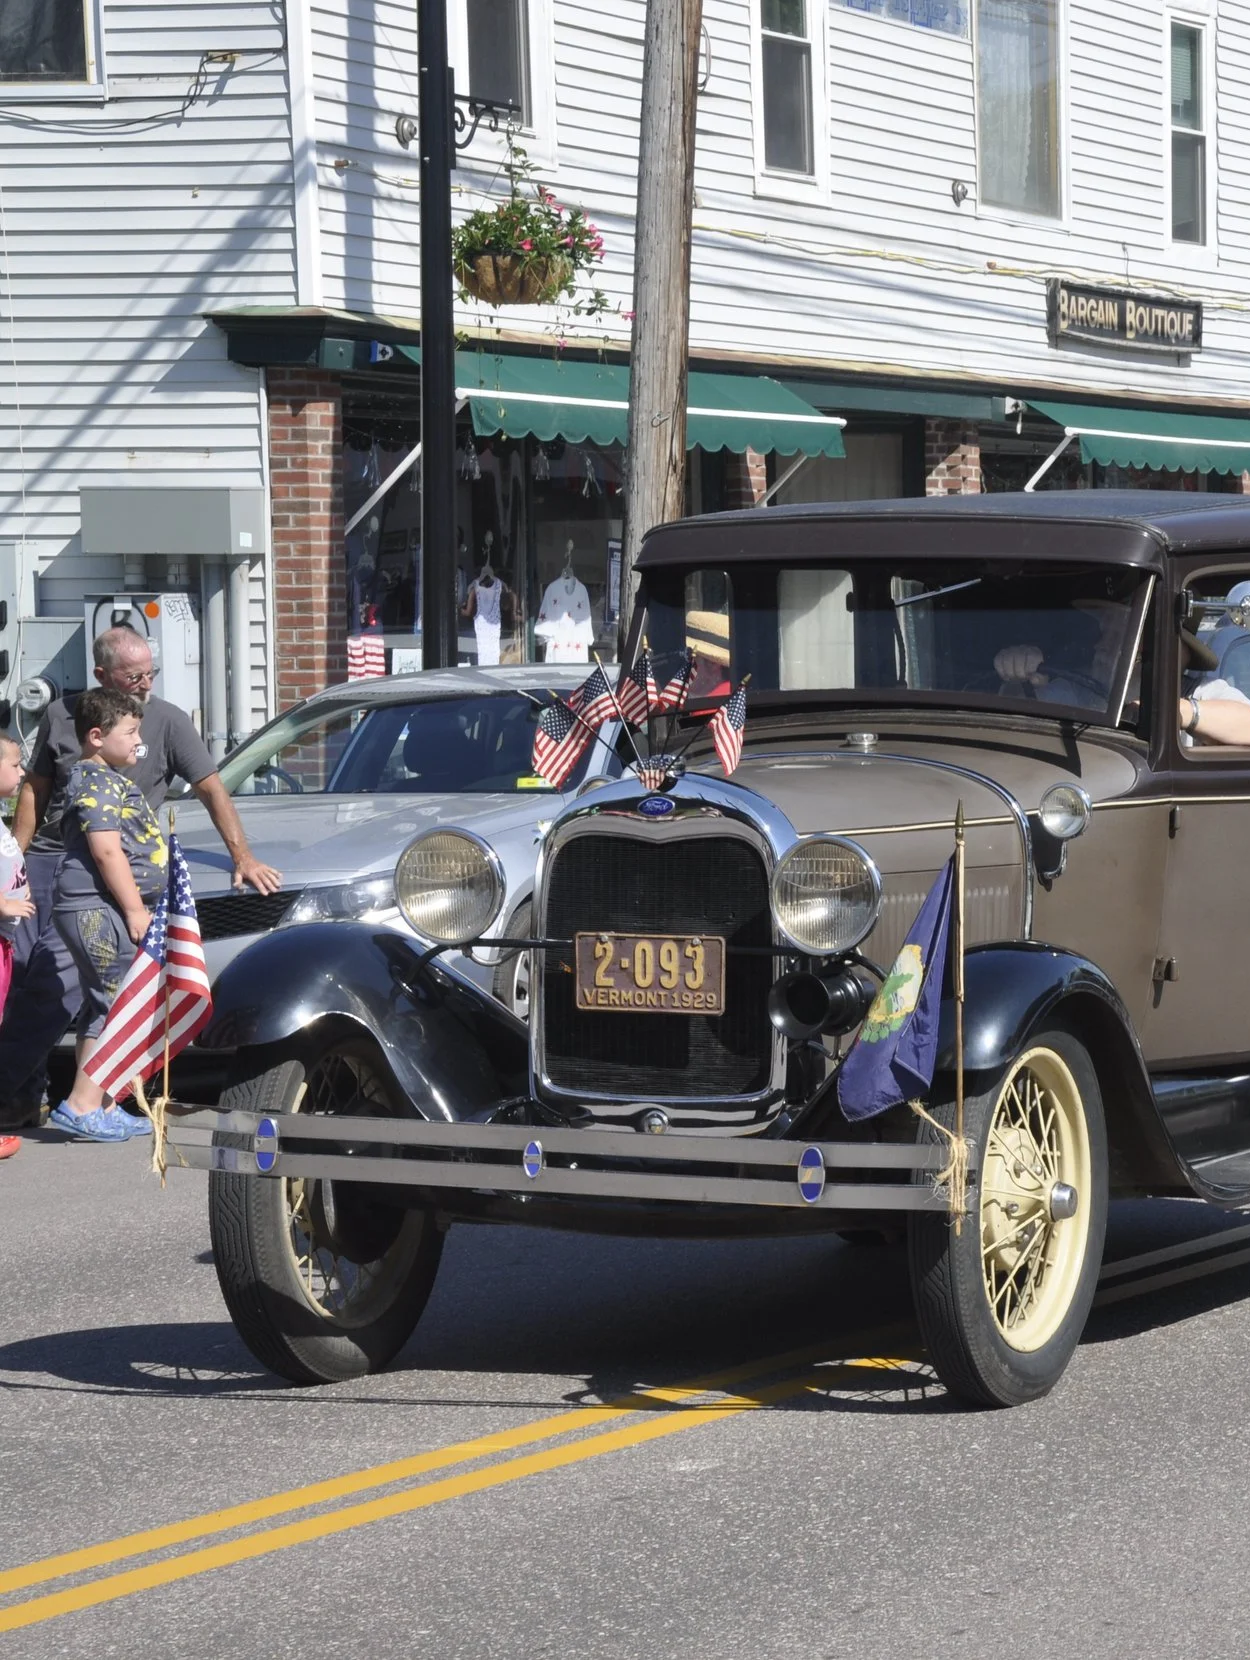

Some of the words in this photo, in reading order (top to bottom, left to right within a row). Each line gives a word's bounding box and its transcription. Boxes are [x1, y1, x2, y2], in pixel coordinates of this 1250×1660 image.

[1060, 289, 1118, 331] BARGAIN
[1126, 300, 1194, 343] BOUTIQUE
[642, 800, 671, 814] Ford
[583, 988, 668, 1007] VERMONT
[672, 991, 717, 1009] 1929
